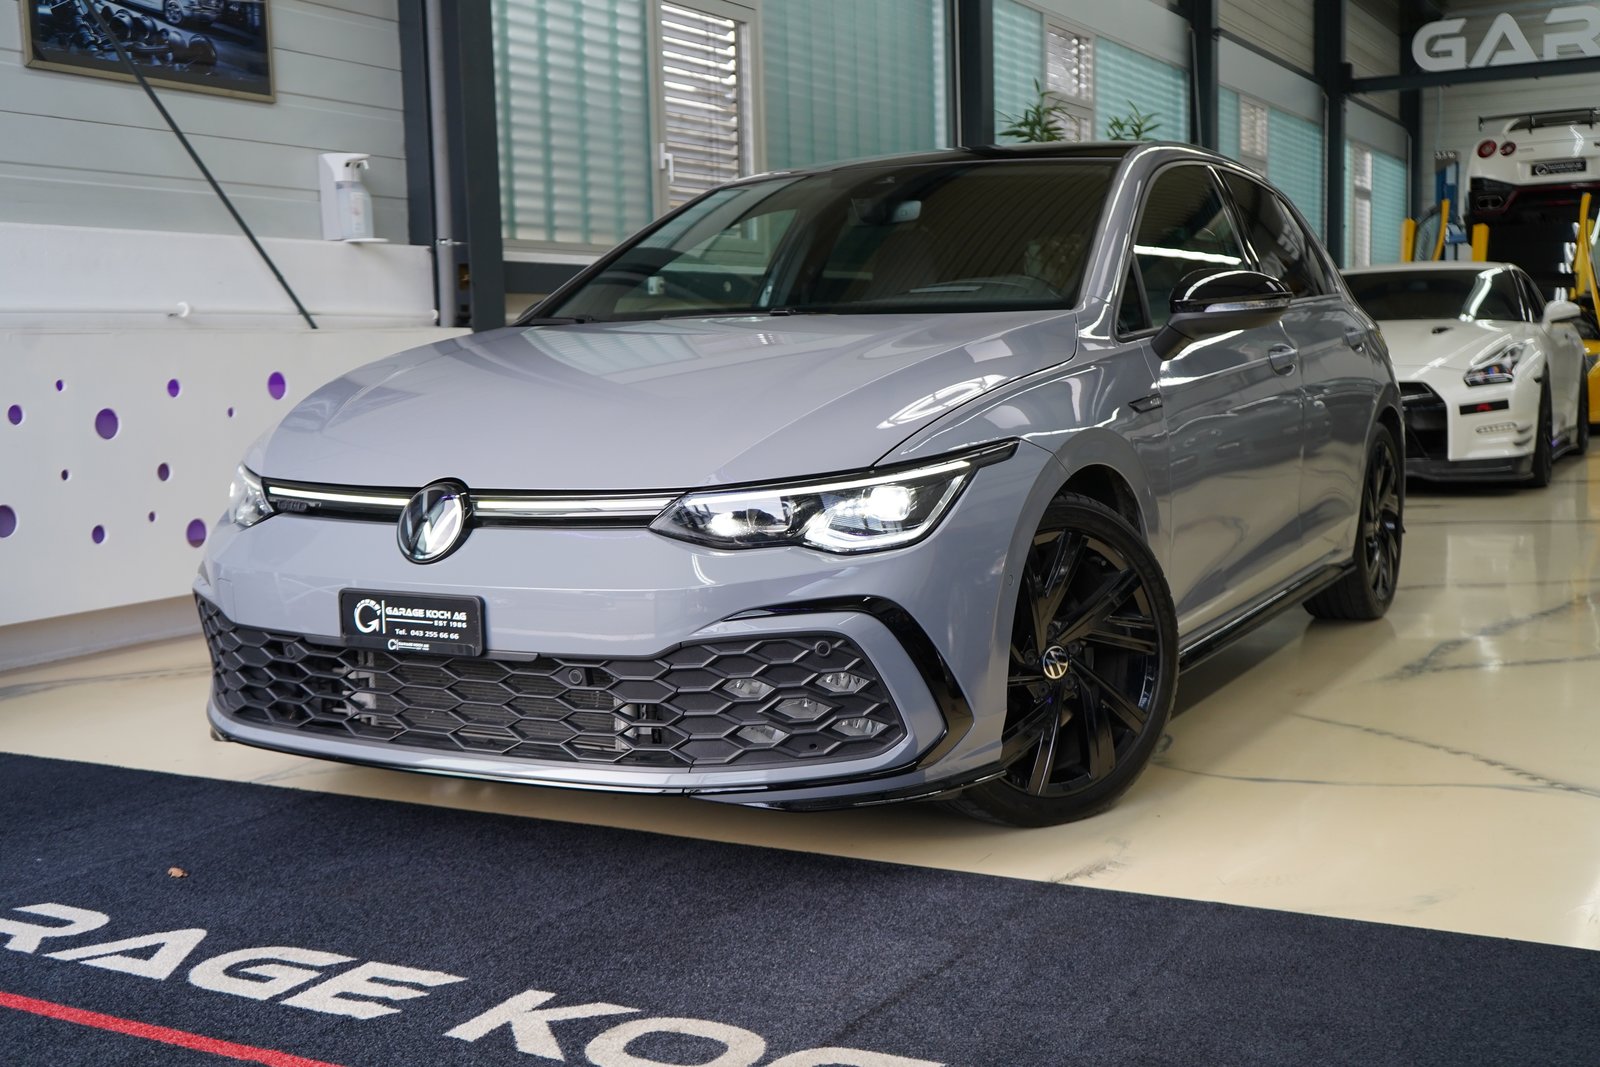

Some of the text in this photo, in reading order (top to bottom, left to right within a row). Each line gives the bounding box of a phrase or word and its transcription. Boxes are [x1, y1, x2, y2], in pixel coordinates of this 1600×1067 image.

[1411, 5, 1600, 73] GAR
[385, 606, 467, 621] GARAGE KOCH AG
[410, 629, 424, 637] 043
[424, 630, 438, 638] 255
[439, 631, 449, 639] 66
[449, 632, 460, 640] 66
[0, 902, 468, 1019] RAGE
